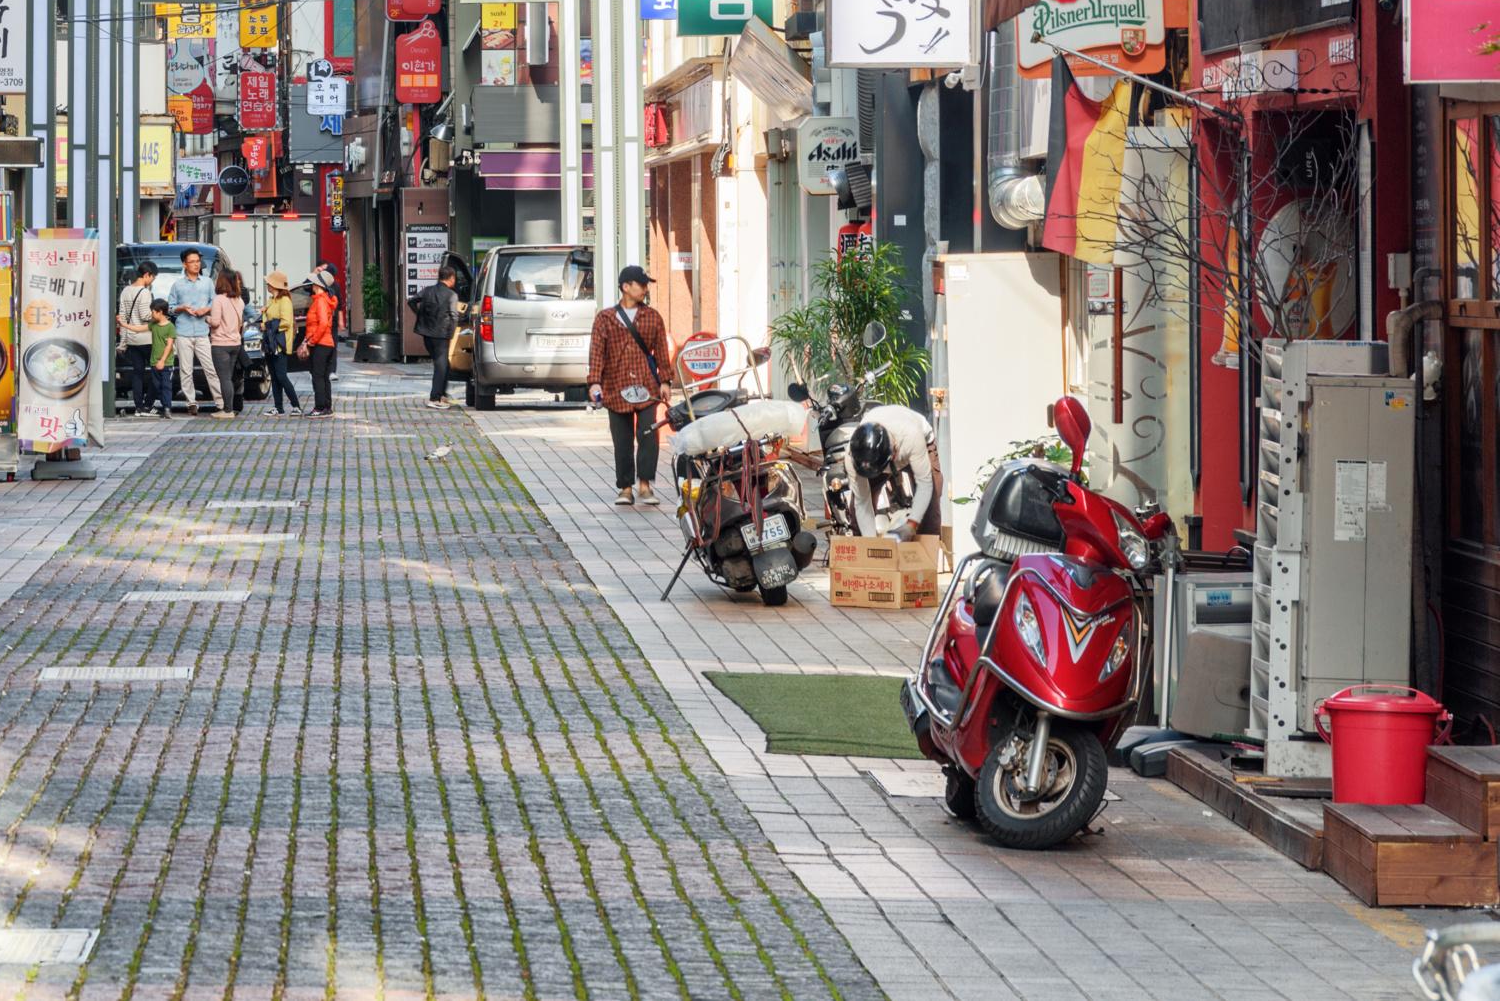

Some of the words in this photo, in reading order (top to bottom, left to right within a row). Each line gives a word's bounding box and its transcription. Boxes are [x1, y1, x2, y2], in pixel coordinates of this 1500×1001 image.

[1032, 0, 1091, 38] Pilsner
[246, 76, 269, 88] 제일
[242, 101, 274, 113] 연습장
[807, 141, 859, 162] Asahi
[28, 273, 86, 299] 뚝배기
[39, 416, 63, 441] 맛
